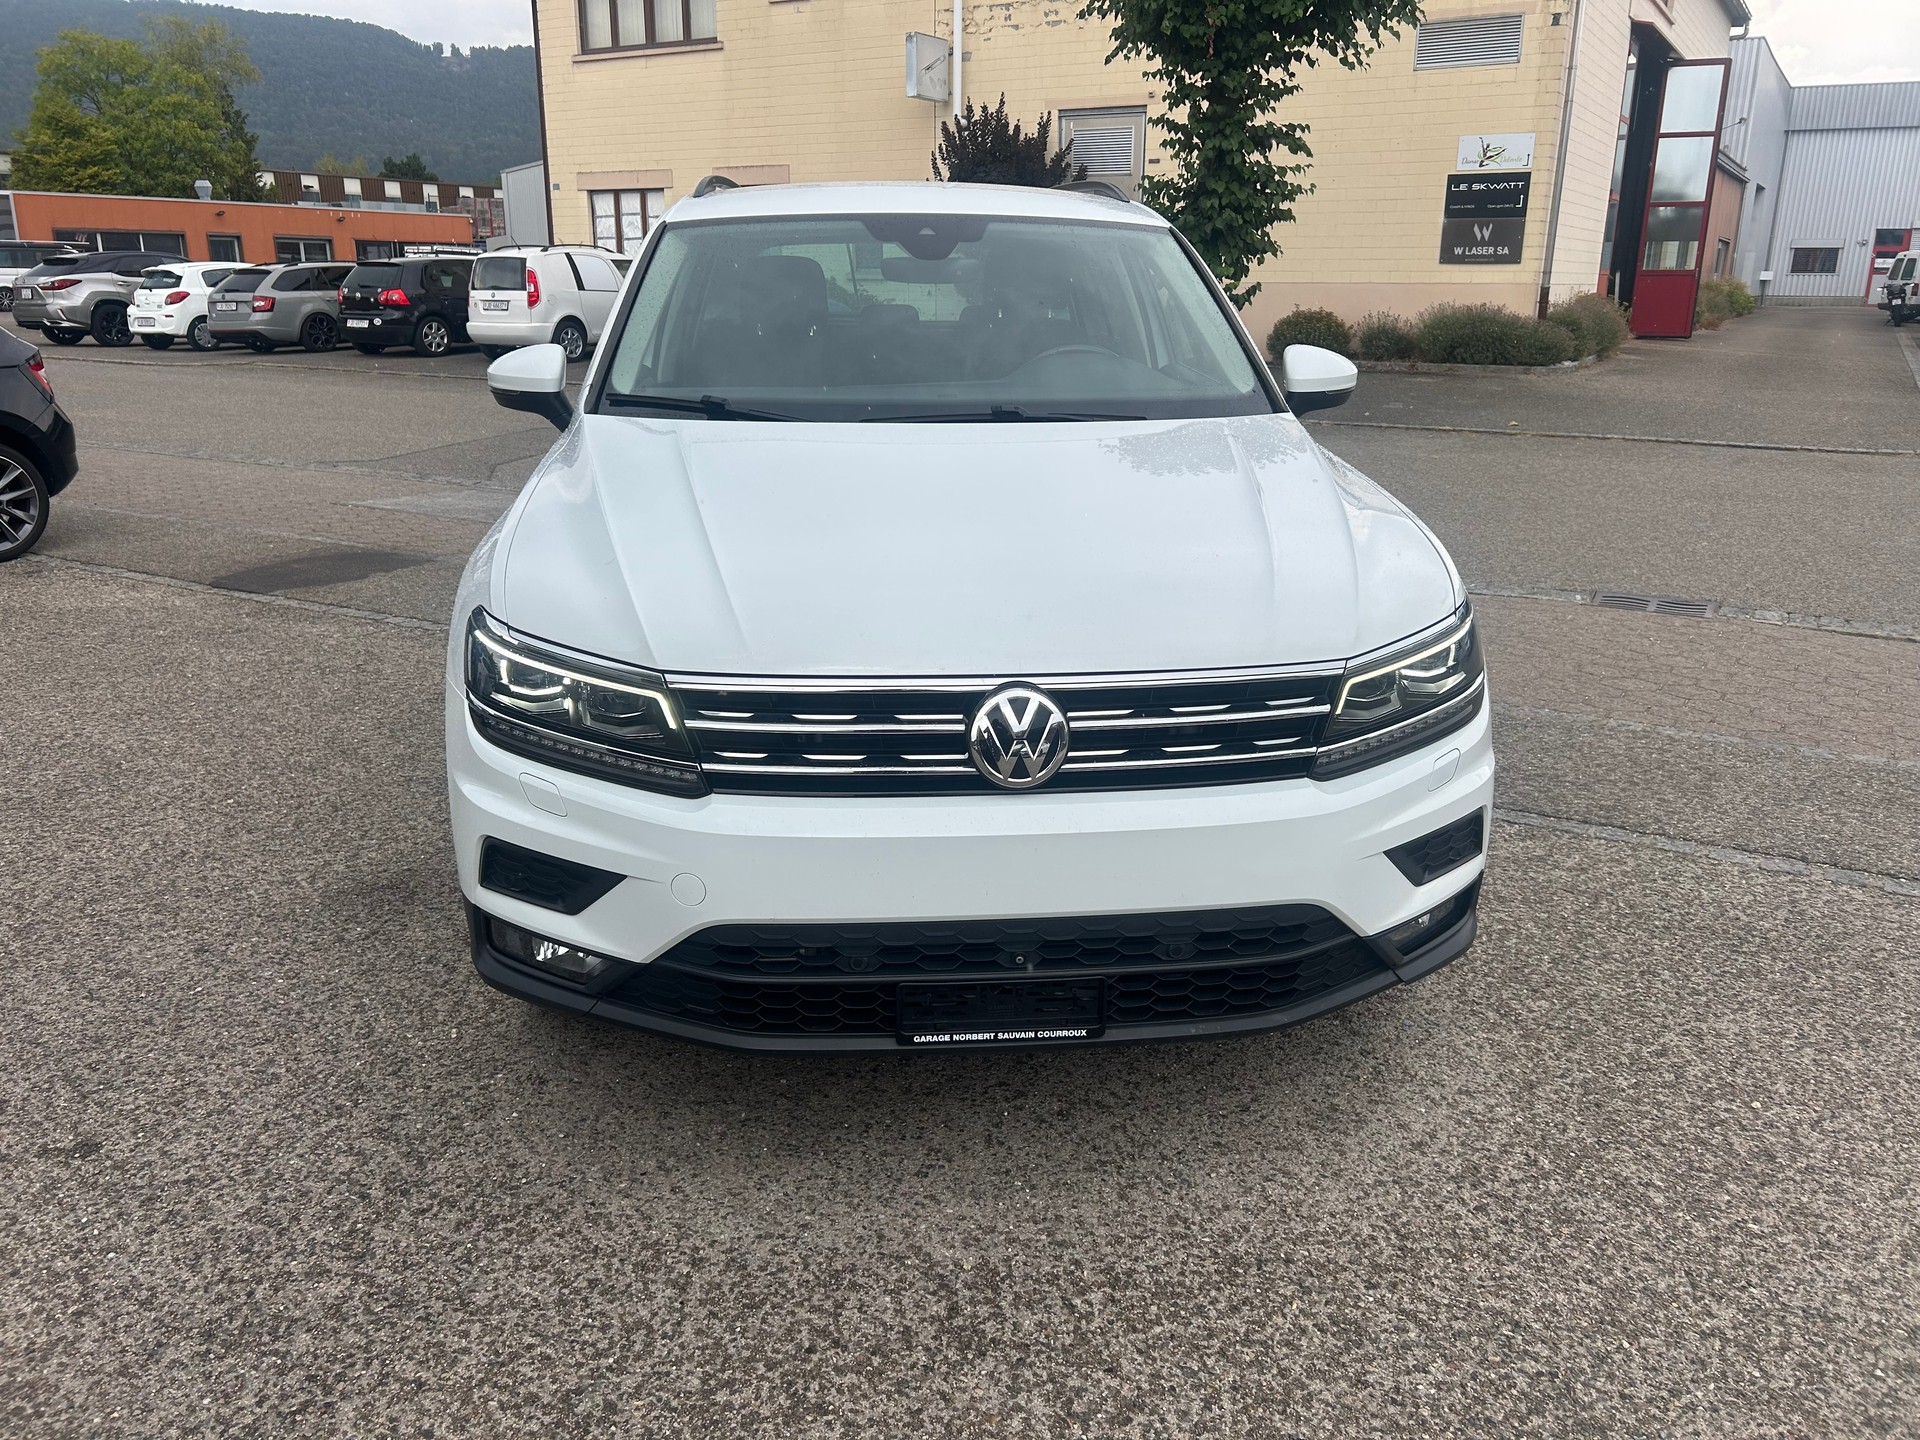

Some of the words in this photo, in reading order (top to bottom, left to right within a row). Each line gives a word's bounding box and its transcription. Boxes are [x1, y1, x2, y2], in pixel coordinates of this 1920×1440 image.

[1451, 183, 1468, 191] LE
[1471, 181, 1525, 191] SKWATT
[1453, 247, 1464, 255] W
[1465, 246, 1494, 255] LASER
[1496, 246, 1509, 255] SA
[913, 1034, 951, 1043] GARAGE
[952, 1032, 996, 1041] NORBERT
[997, 1031, 1035, 1040] SAUVAIN
[1037, 1029, 1087, 1038] COURROUX
